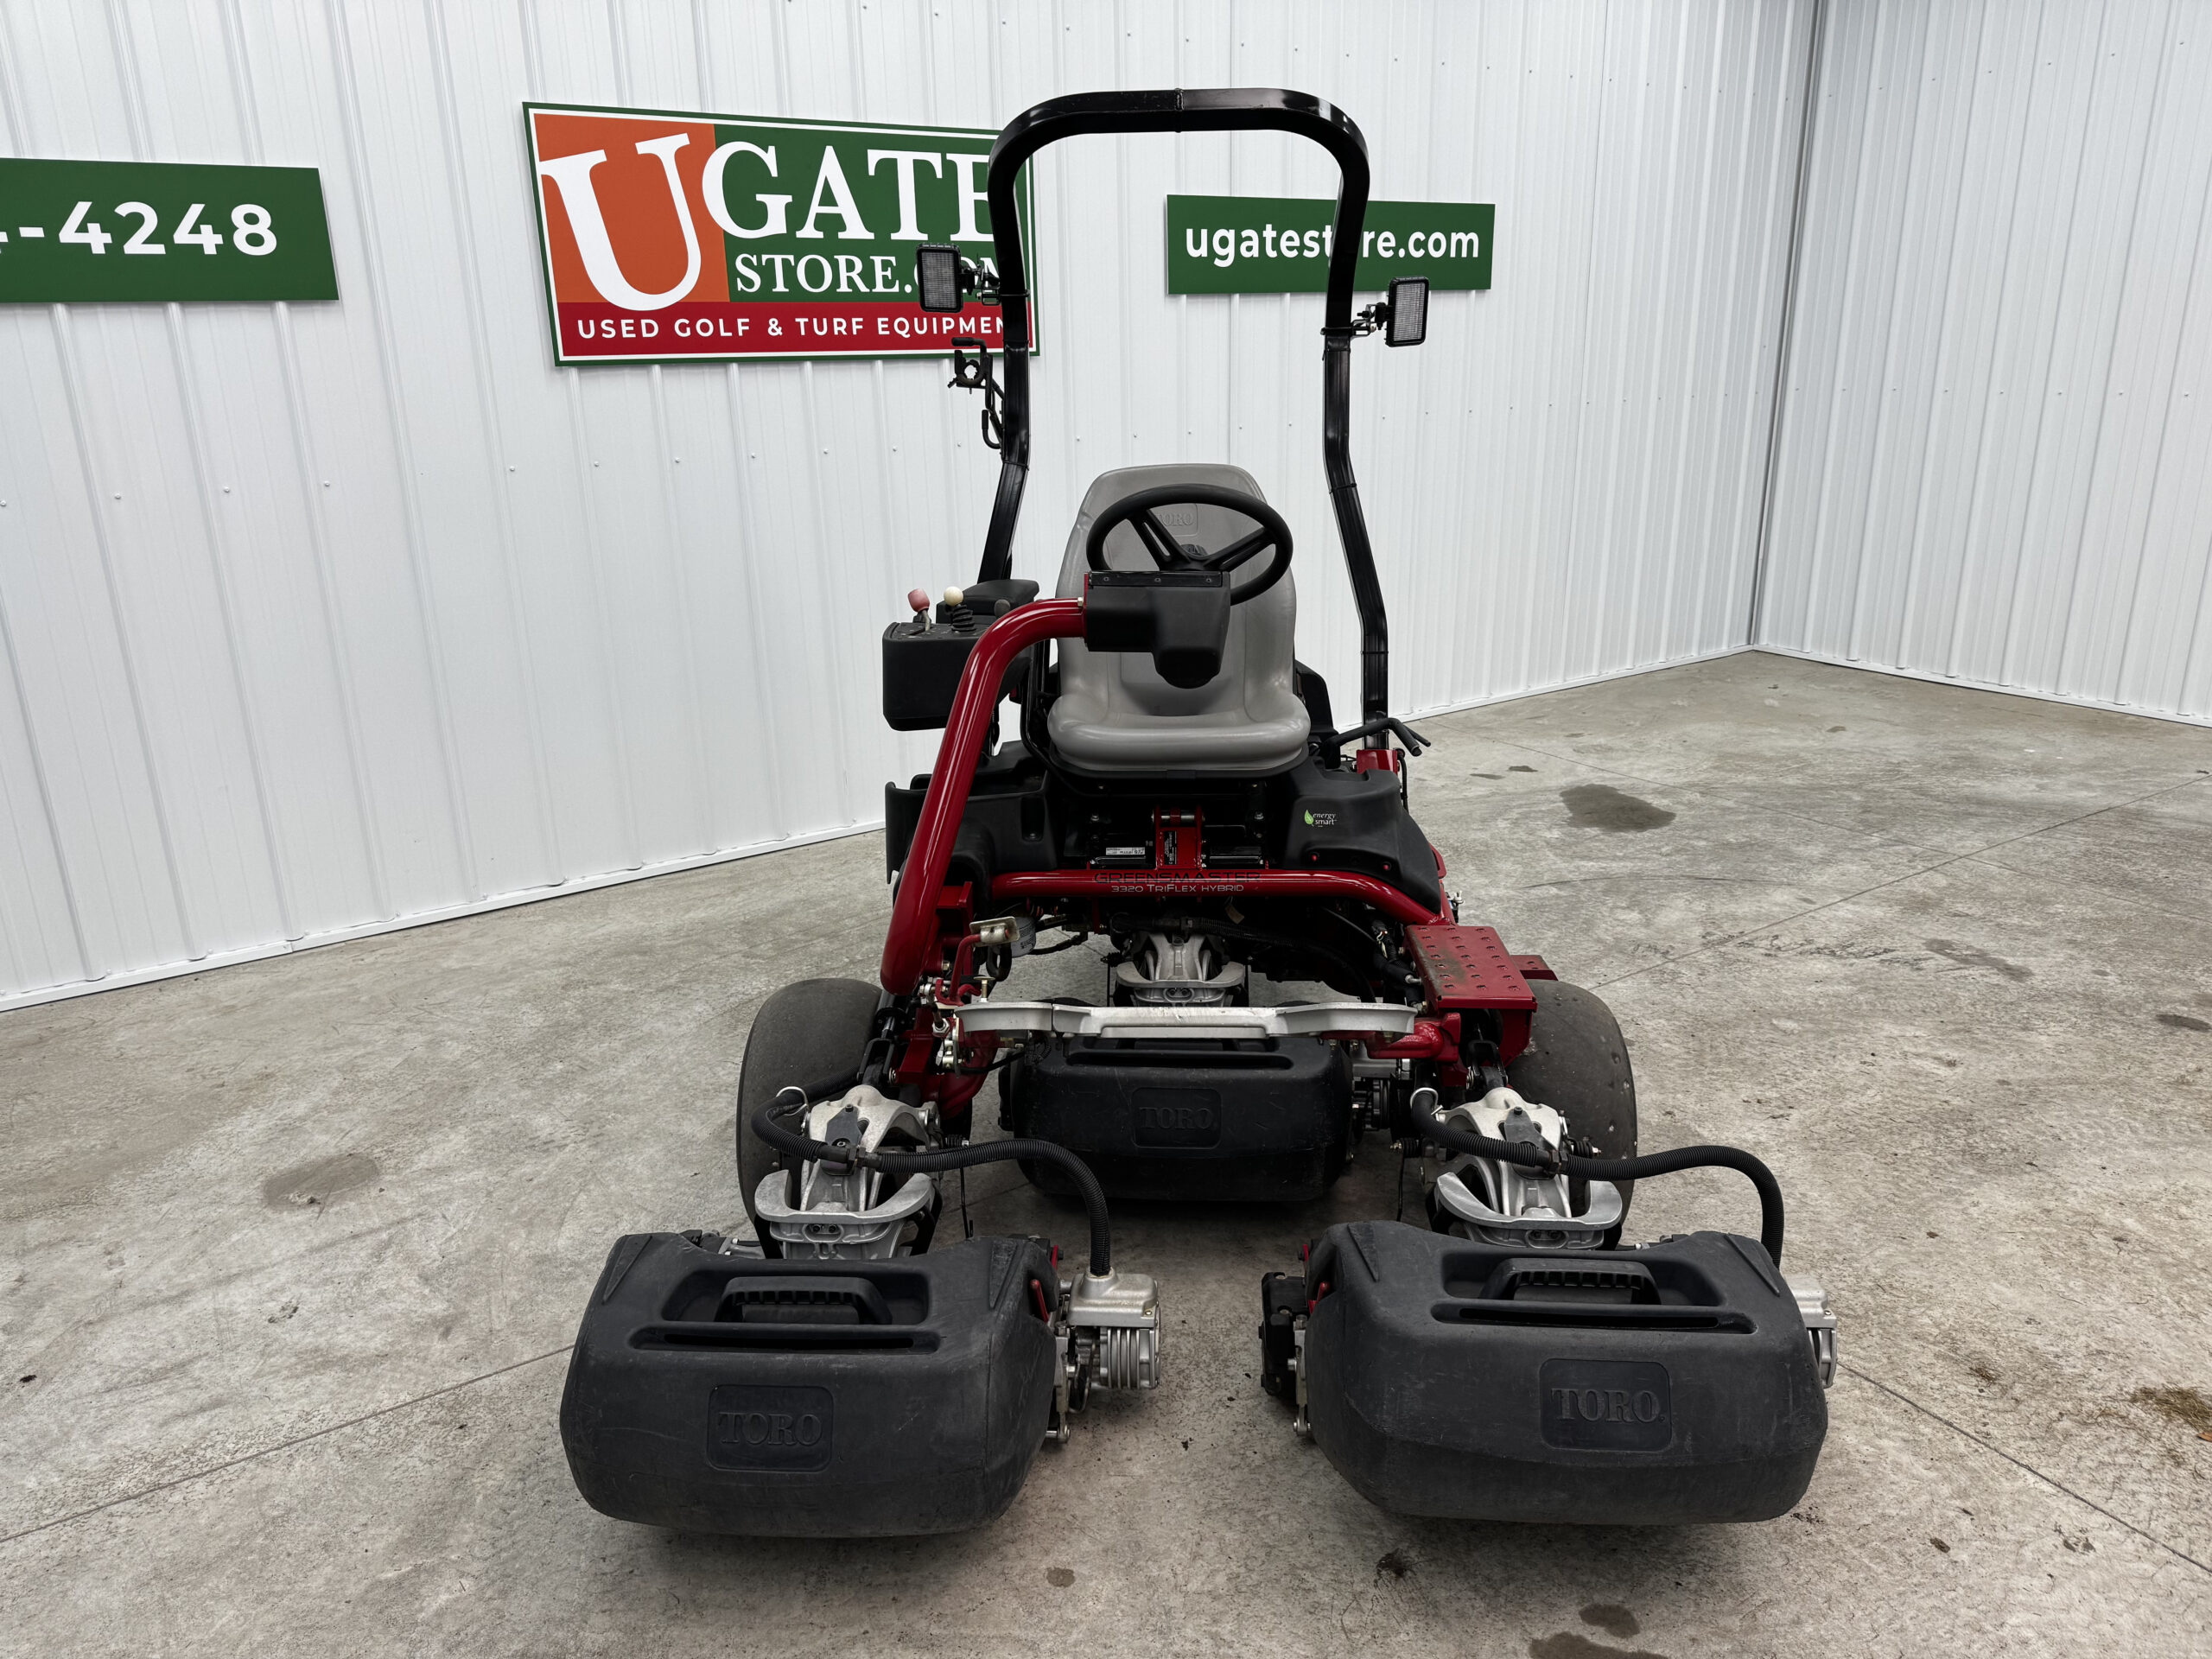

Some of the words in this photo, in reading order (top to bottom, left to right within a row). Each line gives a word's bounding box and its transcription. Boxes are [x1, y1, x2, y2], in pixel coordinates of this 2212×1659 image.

[0, 200, 277, 256] -4248
[539, 132, 995, 311] UGATE
[1185, 224, 1479, 268] ugatestre.com
[735, 253, 1001, 295] STORE.
[577, 319, 659, 339] USED
[674, 318, 751, 338] GOLF
[767, 318, 784, 337] &
[795, 317, 864, 336] TURF
[1094, 872, 1262, 884] GREENSMASTER
[1139, 1107, 1213, 1129] TORO
[1551, 1388, 1661, 1424] TORO
[718, 1411, 823, 1447] TORO
